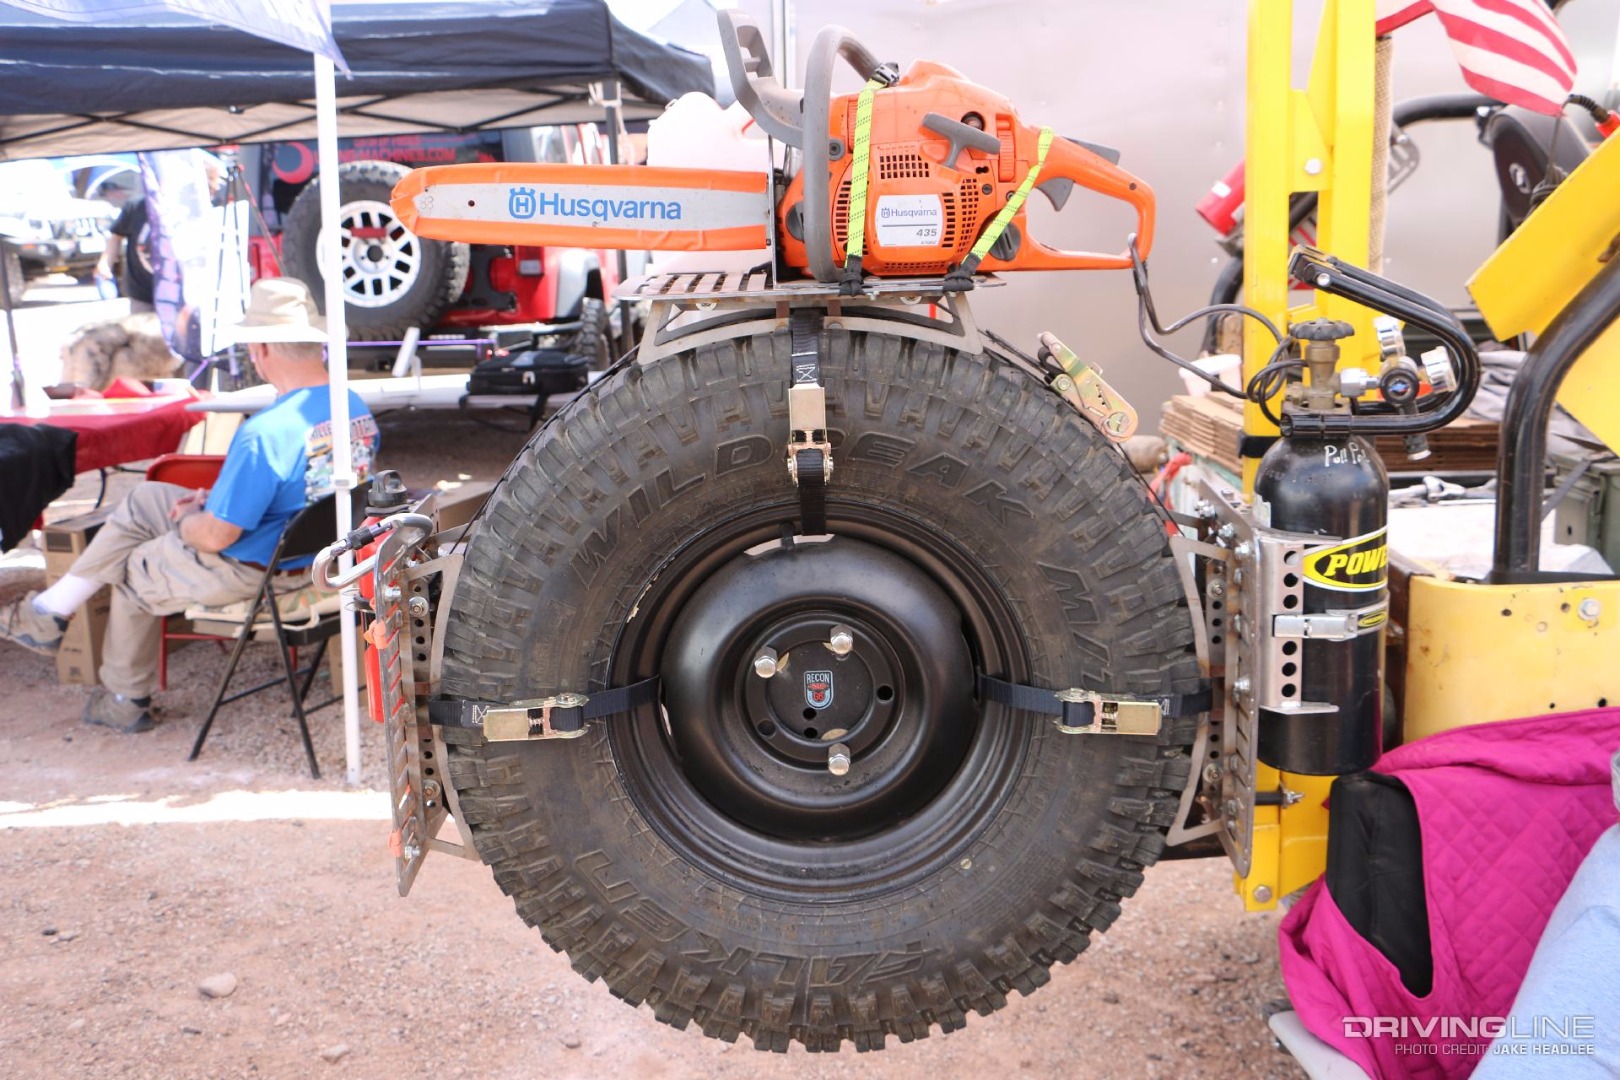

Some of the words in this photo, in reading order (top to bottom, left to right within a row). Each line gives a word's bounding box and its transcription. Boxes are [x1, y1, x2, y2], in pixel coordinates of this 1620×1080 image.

[539, 192, 682, 222] Husqvarna
[891, 208, 937, 218] Husqvarna
[916, 228, 938, 237] 435
[806, 672, 830, 684] RECON
